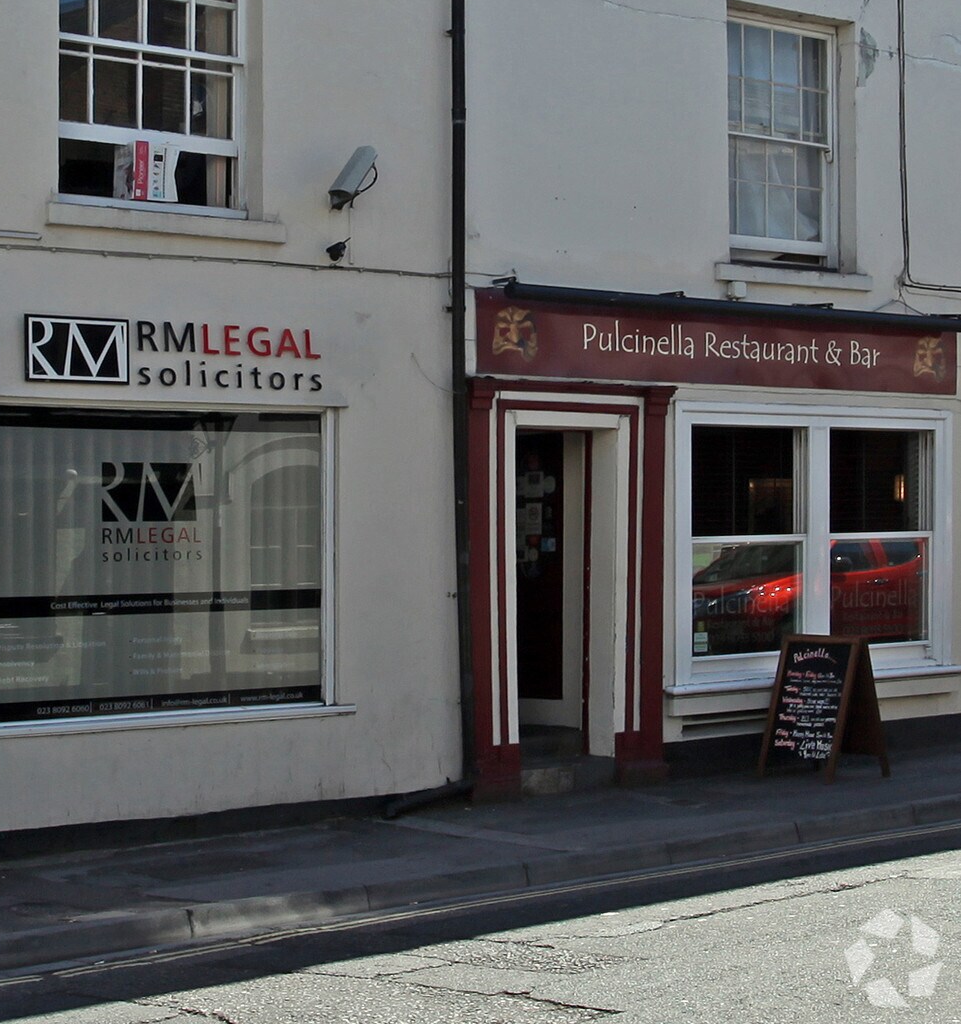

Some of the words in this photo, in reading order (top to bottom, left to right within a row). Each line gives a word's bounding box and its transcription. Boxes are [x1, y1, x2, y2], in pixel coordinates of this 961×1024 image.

[137, 320, 321, 360] RMLEGAL
[582, 320, 694, 359] Pulcinella
[704, 331, 819, 364] Restaurant
[825, 340, 841, 366] &
[849, 340, 881, 369] Bar
[138, 360, 323, 392] solicitors
[102, 527, 201, 544] RMLEGAL
[102, 548, 203, 563] solicitors
[50, 601, 67, 610] Cost
[68, 600, 98, 609] Effective
[100, 600, 119, 609] Legal
[120, 599, 152, 608] Solutions
[164, 598, 199, 606] Businesses
